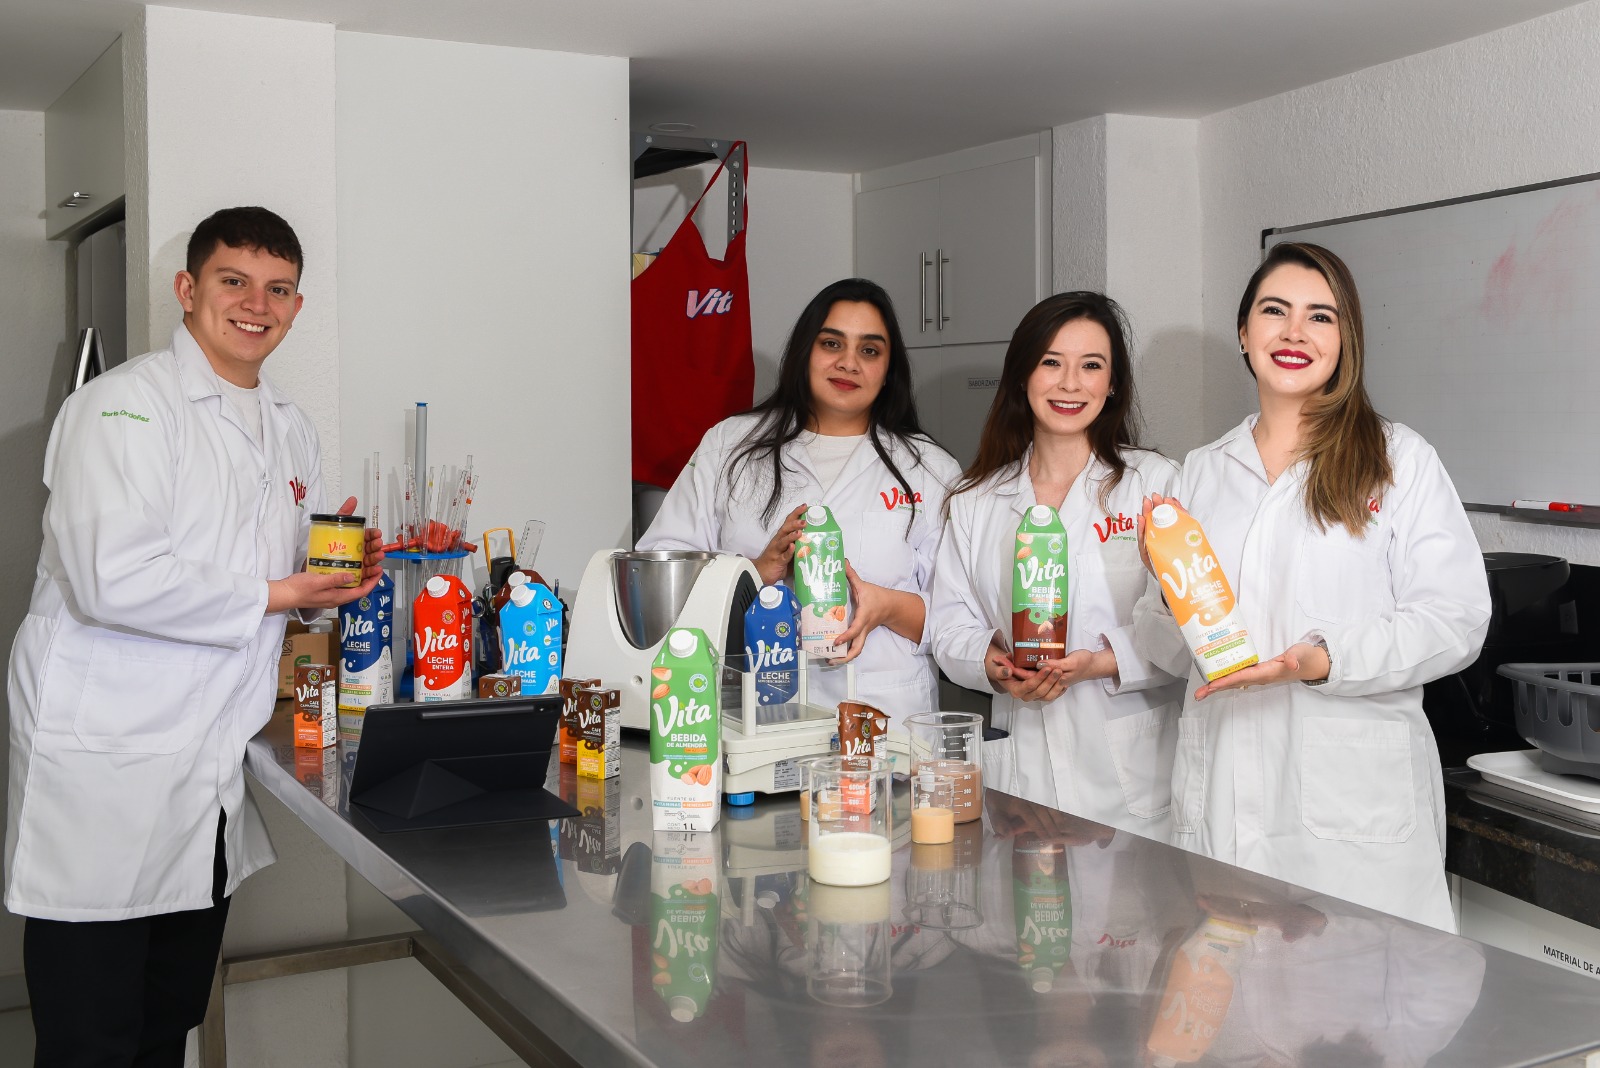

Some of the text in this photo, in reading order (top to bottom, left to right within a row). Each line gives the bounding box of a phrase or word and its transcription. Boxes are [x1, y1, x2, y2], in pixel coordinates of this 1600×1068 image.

[1093, 512, 1135, 543] Vita
[328, 541, 347, 553] Vita
[797, 553, 843, 588] Vita
[1017, 555, 1066, 590] Vita
[1161, 552, 1218, 600] Vita
[1190, 579, 1223, 598] LECHE
[340, 612, 375, 643] Vita
[545, 618, 559, 632] Vita
[346, 640, 371, 649] LECHE
[414, 626, 459, 660] Vita
[427, 656, 454, 665] LECHE
[502, 637, 541, 672] Vita
[745, 639, 795, 674] Vita
[761, 672, 790, 680] LECHE
[295, 683, 320, 703] Vita
[562, 697, 578, 717] Vit
[653, 695, 712, 738] Vita
[578, 709, 602, 729] Vita
[670, 733, 707, 742] BEBIDA
[845, 737, 872, 757] Vita
[683, 822, 688, 830] 1
[690, 822, 697, 831] L
[1543, 944, 1582, 969] MATERIAL
[1583, 960, 1594, 974] DE
